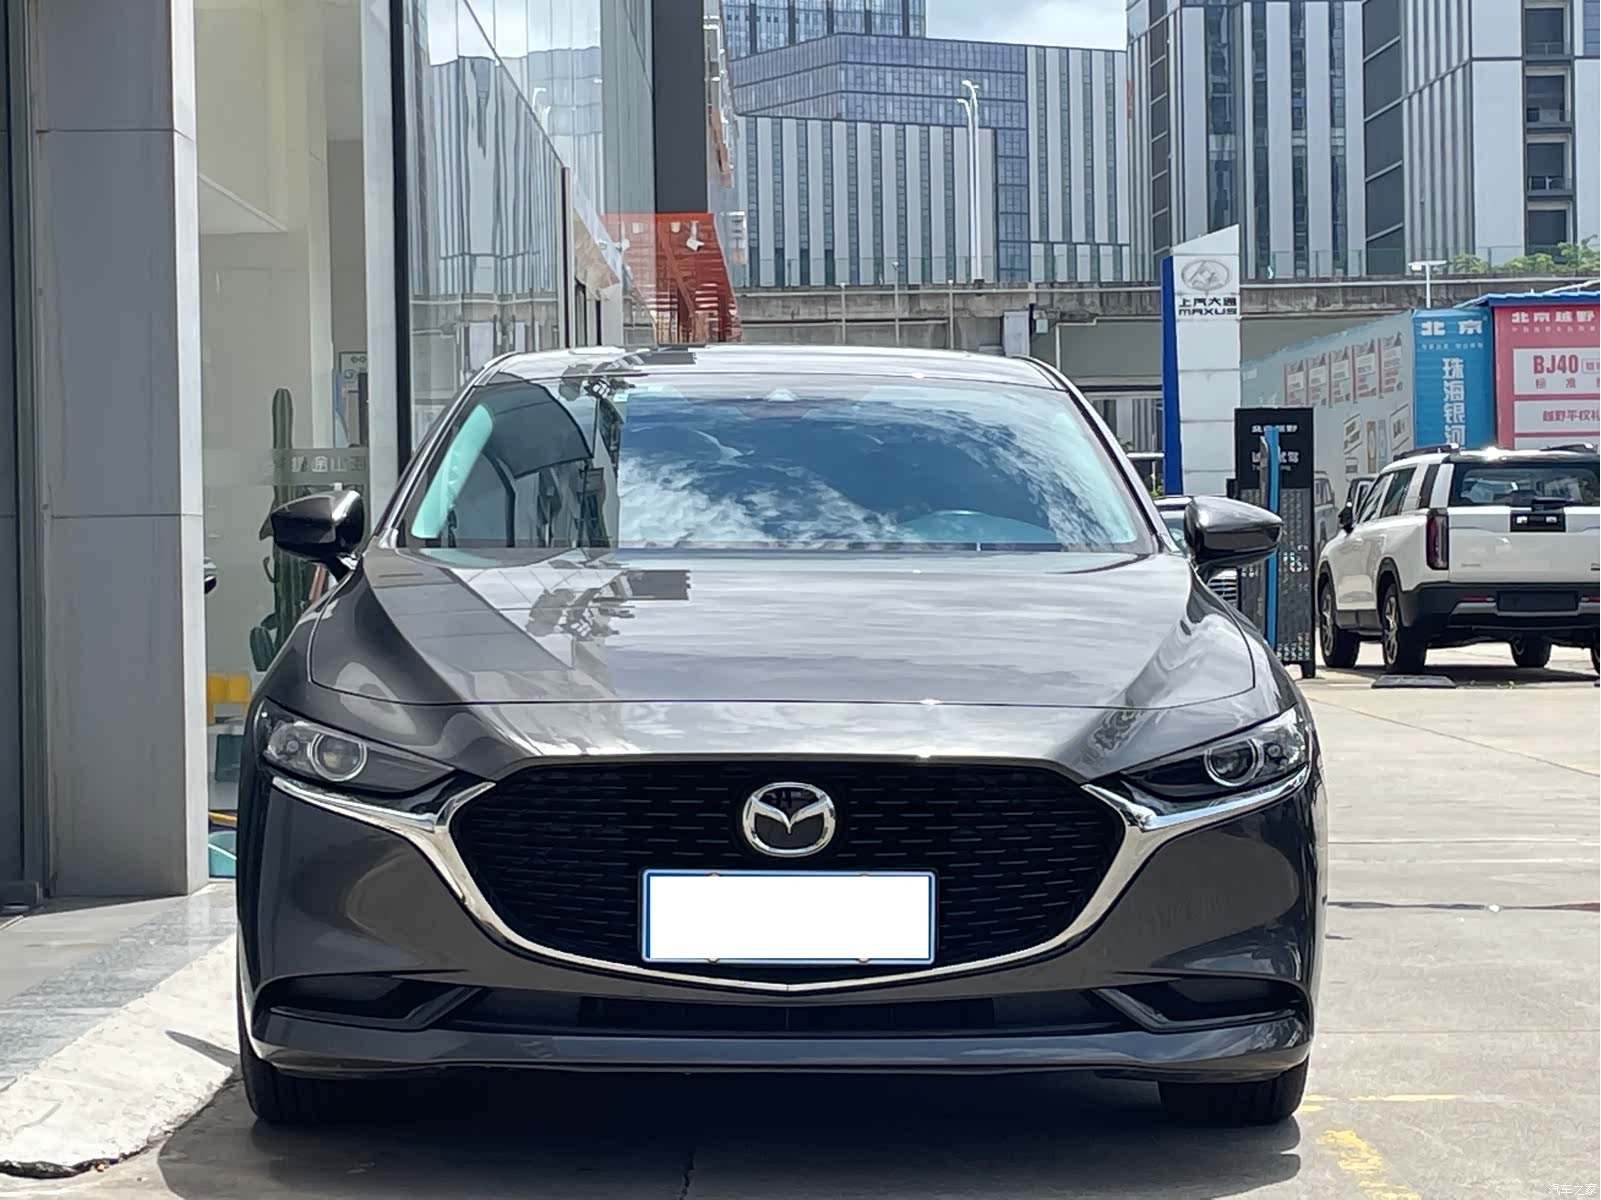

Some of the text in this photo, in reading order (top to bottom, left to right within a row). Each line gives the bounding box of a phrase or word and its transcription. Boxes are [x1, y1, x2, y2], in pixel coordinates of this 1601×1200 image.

[1179, 308, 1237, 316] MAXUS
[1421, 320, 1483, 336] 北京
[1533, 355, 1579, 374] BJ40
